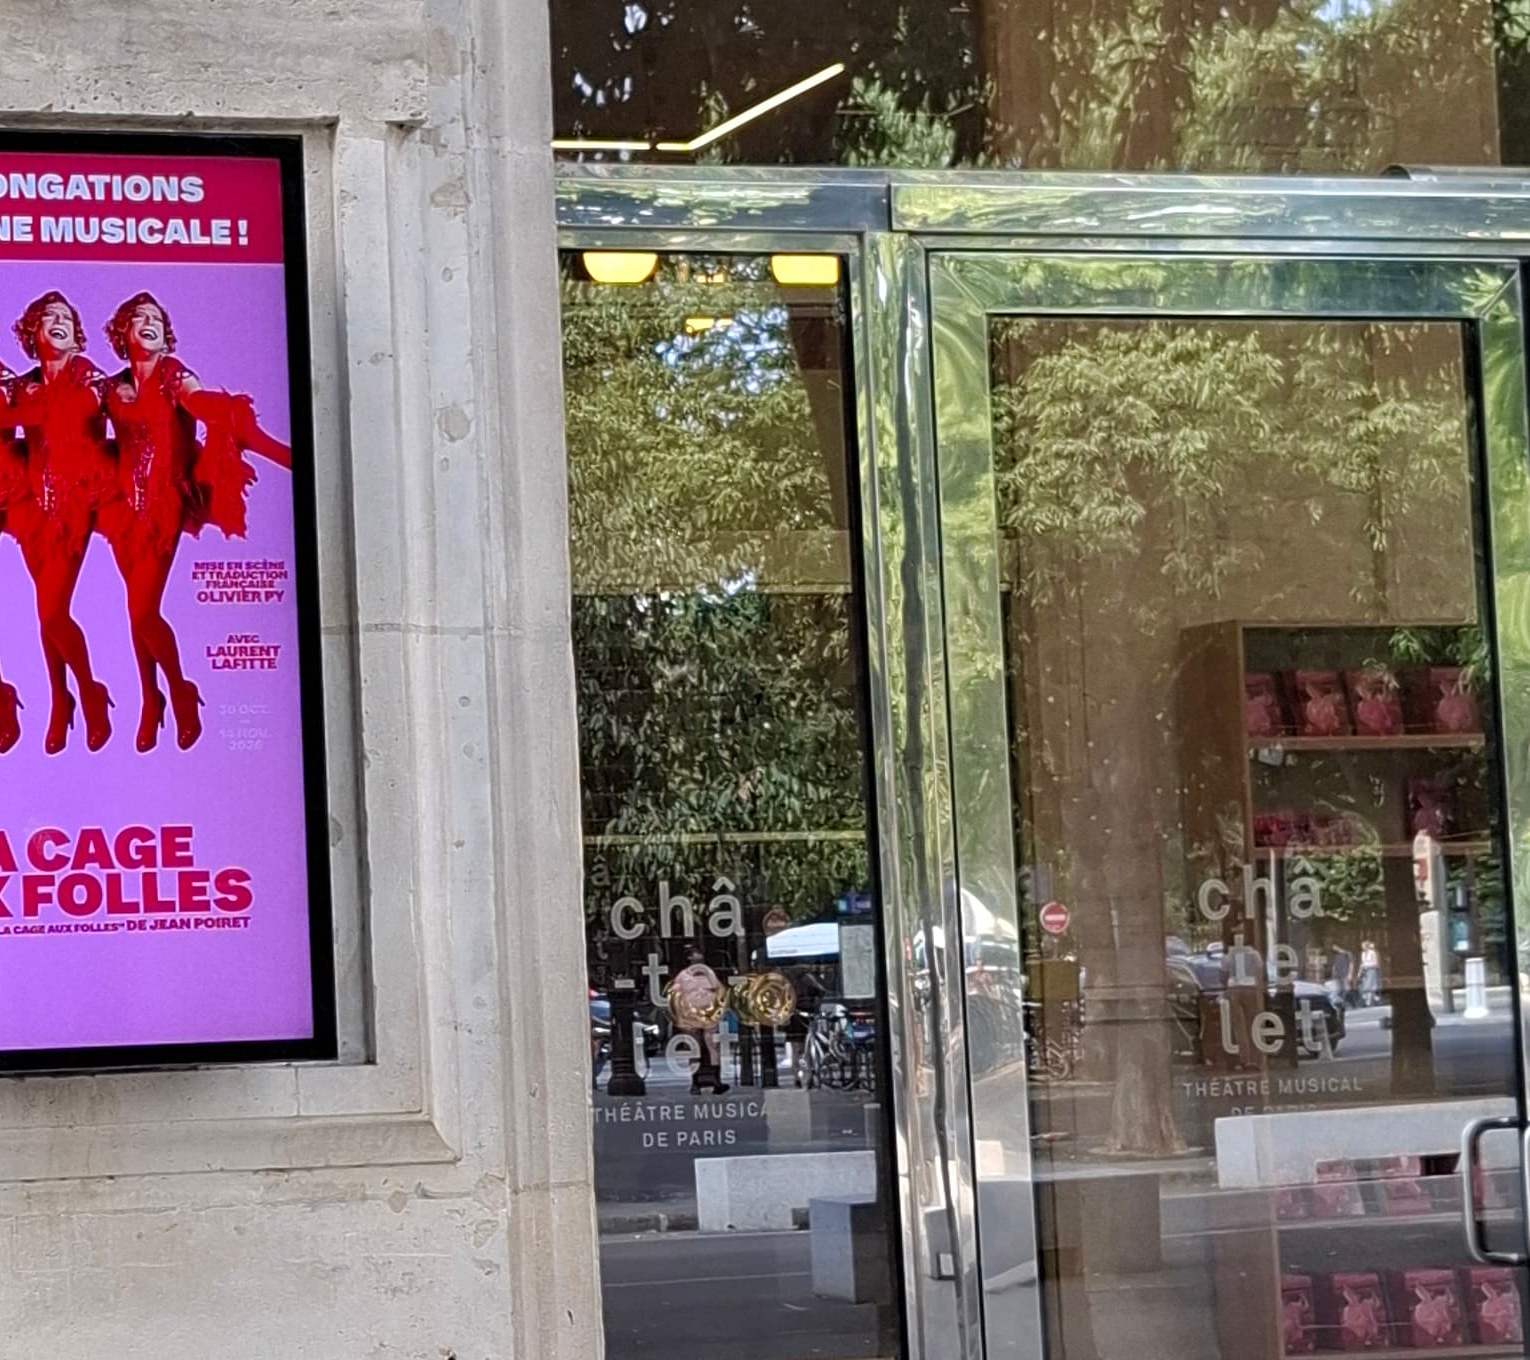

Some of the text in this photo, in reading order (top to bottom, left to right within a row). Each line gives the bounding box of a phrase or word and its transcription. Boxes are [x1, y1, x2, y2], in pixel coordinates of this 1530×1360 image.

[40, 216, 232, 245] MUSICALE
[194, 558, 285, 570] MISE EN SCÈNE
[192, 571, 288, 580] ET TRADUCTION
[205, 580, 275, 590] FRANÇAISE
[197, 590, 285, 603] OLIVIER PY
[227, 635, 260, 644] AVEC
[205, 645, 281, 657] LAURENT
[212, 658, 277, 670] LAFITTE
[26, 826, 195, 873] CAGE
[22, 868, 253, 918] FOLLES
[1198, 857, 1325, 921] châ
[610, 876, 746, 940] châ
[13, 925, 45, 935] CAGE
[47, 924, 72, 934] AUX
[126, 920, 147, 931] DE
[149, 918, 191, 931] JEAN
[194, 916, 252, 930] POIRET
[1220, 998, 1327, 1055] let
[632, 1021, 740, 1078] let
[1183, 1076, 1363, 1098] THÉÂTRE MUSICAL
[590, 1101, 768, 1123] THÉÂTRE MUSICA
[642, 1129, 737, 1148] DE PARIS
